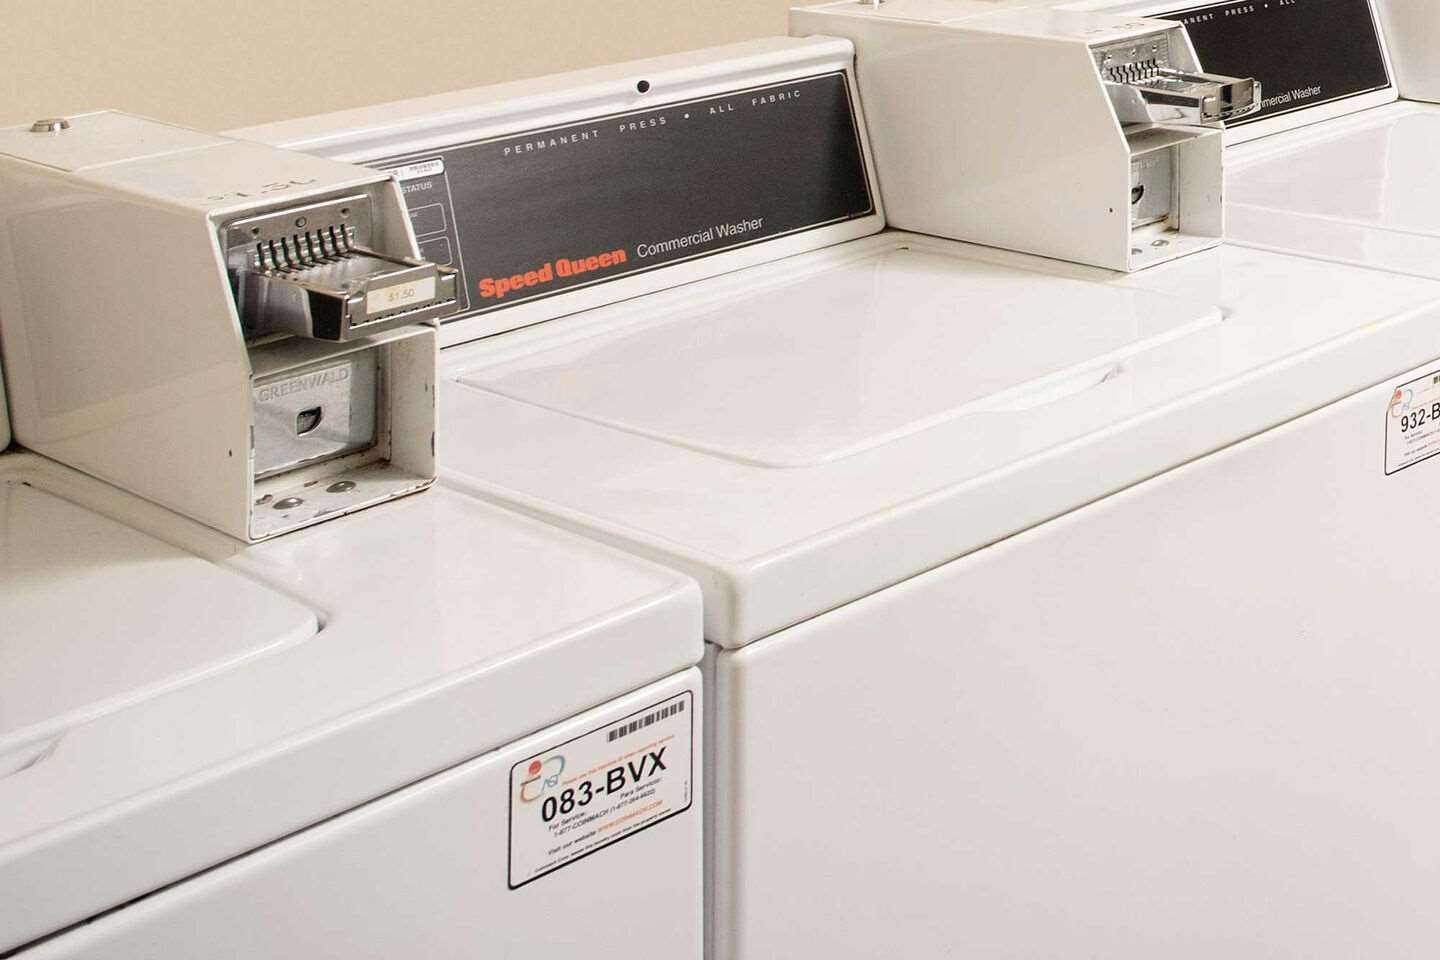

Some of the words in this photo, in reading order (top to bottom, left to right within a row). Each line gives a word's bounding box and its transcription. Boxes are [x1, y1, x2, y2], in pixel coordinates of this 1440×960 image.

[1225, 6, 1255, 17] PRESS
[1292, 84, 1321, 100] Washer
[504, 130, 600, 156] PERMANENT
[619, 116, 667, 133] PRESS
[709, 104, 735, 115] ALL
[751, 89, 802, 106] FABRIC
[401, 182, 432, 193] STATUS
[479, 262, 553, 299] Speed
[556, 247, 627, 277] Queen
[637, 230, 714, 259] Commercial
[715, 216, 764, 242] Washer
[258, 367, 349, 403] GREENWALD
[542, 746, 666, 822] 083-BVX
